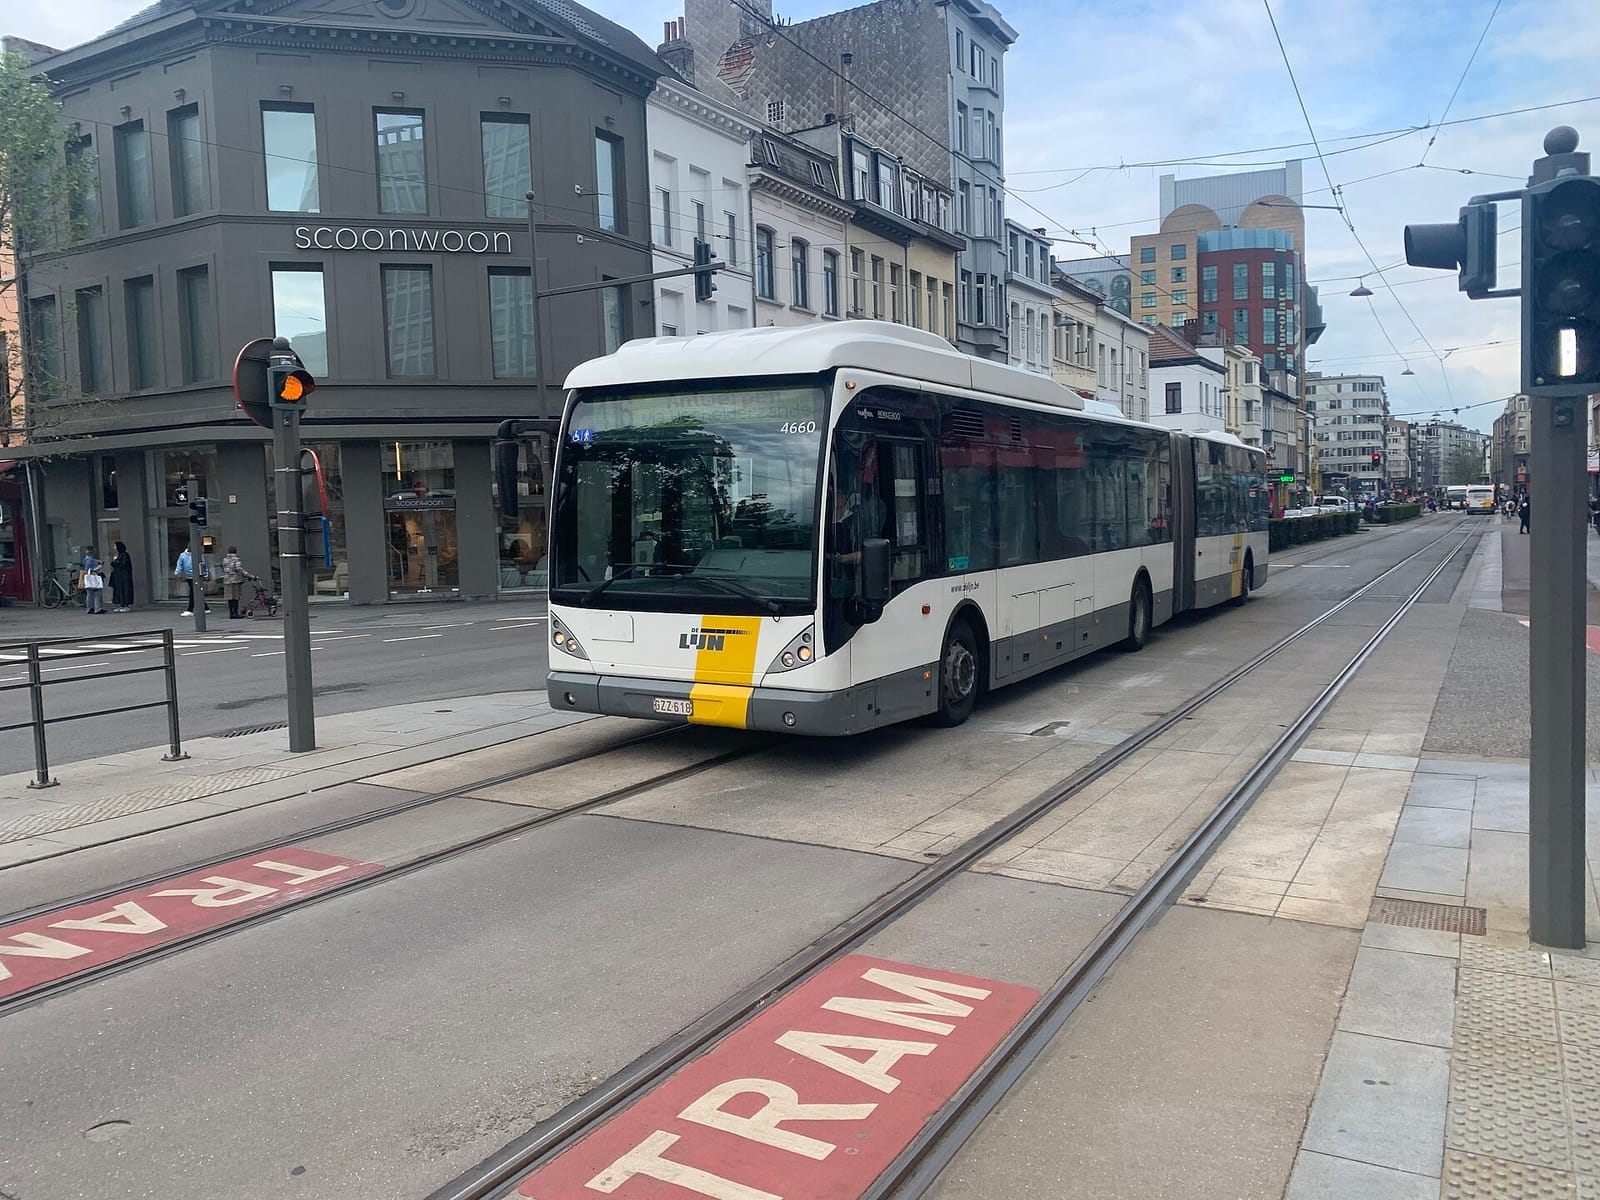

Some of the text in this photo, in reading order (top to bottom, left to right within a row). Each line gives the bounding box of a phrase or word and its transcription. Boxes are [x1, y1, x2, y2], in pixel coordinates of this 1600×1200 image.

[295, 226, 512, 253] scoonwoon
[1276, 288, 1286, 359] chocolate
[780, 421, 816, 435] 4660
[584, 967, 993, 1200] TRAM
